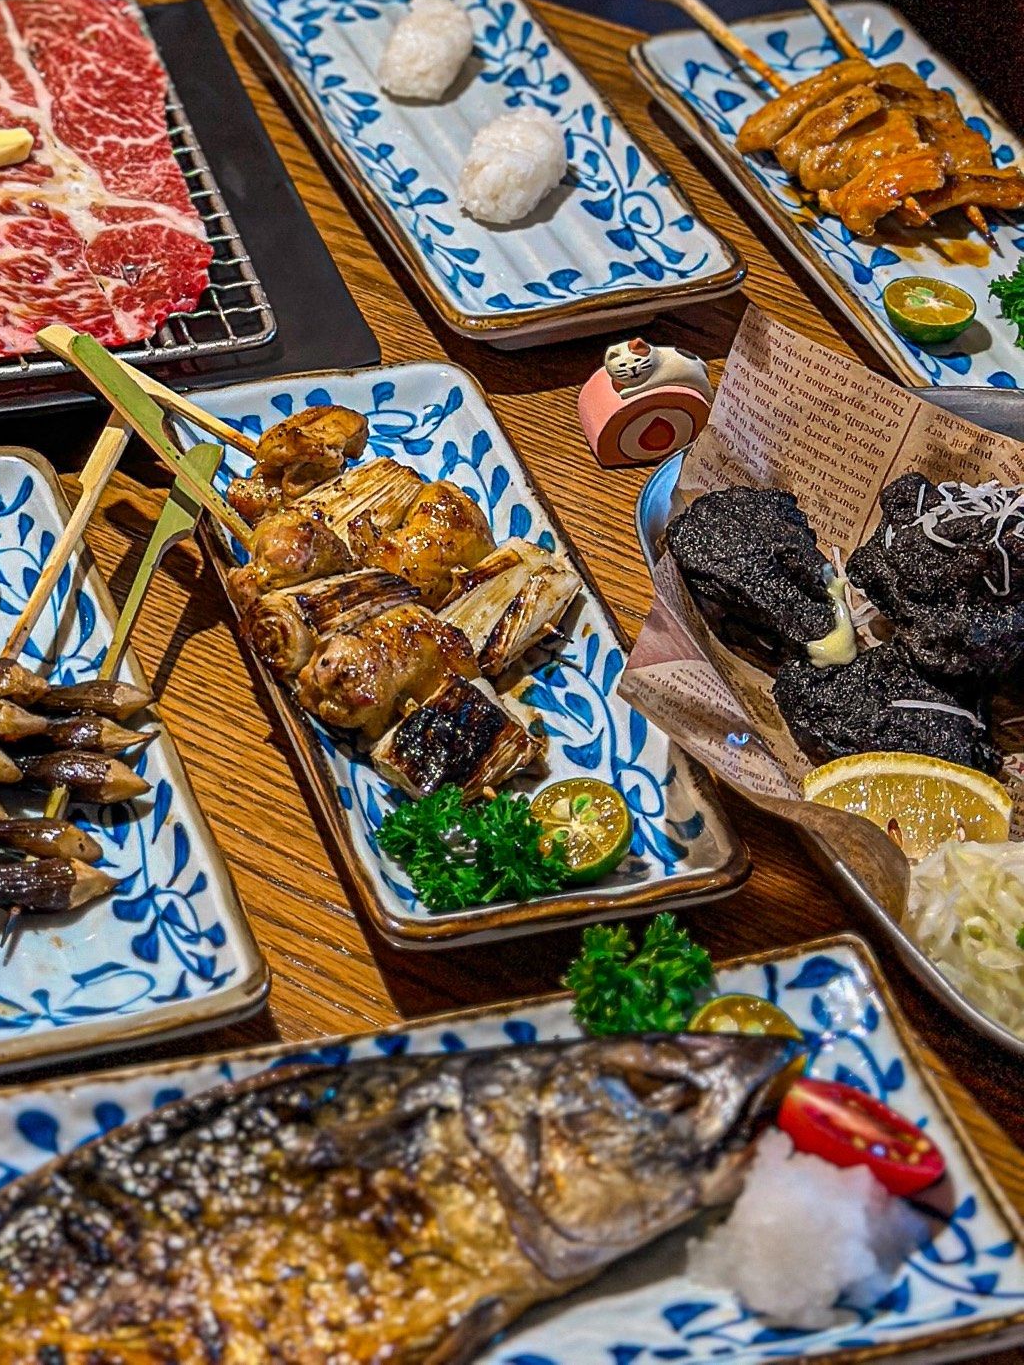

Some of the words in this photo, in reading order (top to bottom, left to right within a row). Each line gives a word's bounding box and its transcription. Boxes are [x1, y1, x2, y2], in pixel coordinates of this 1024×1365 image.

[782, 343, 812, 367] lovely
[812, 362, 830, 376] the
[831, 371, 848, 386] for
[850, 380, 871, 395] you
[753, 394, 772, 409] you
[781, 394, 804, 413] very
[870, 391, 905, 417] Thank
[770, 406, 800, 429] which
[806, 410, 841, 434] myself
[867, 406, 885, 422] my
[841, 411, 892, 443] especially
[885, 417, 899, 430] of
[775, 426, 790, 441] for
[802, 423, 830, 445] party
[791, 436, 838, 468] weakness
[847, 449, 878, 474] lovely
[847, 467, 872, 487] have
[808, 481, 821, 492] of
[807, 512, 827, 530] hop
[829, 525, 850, 541] and
